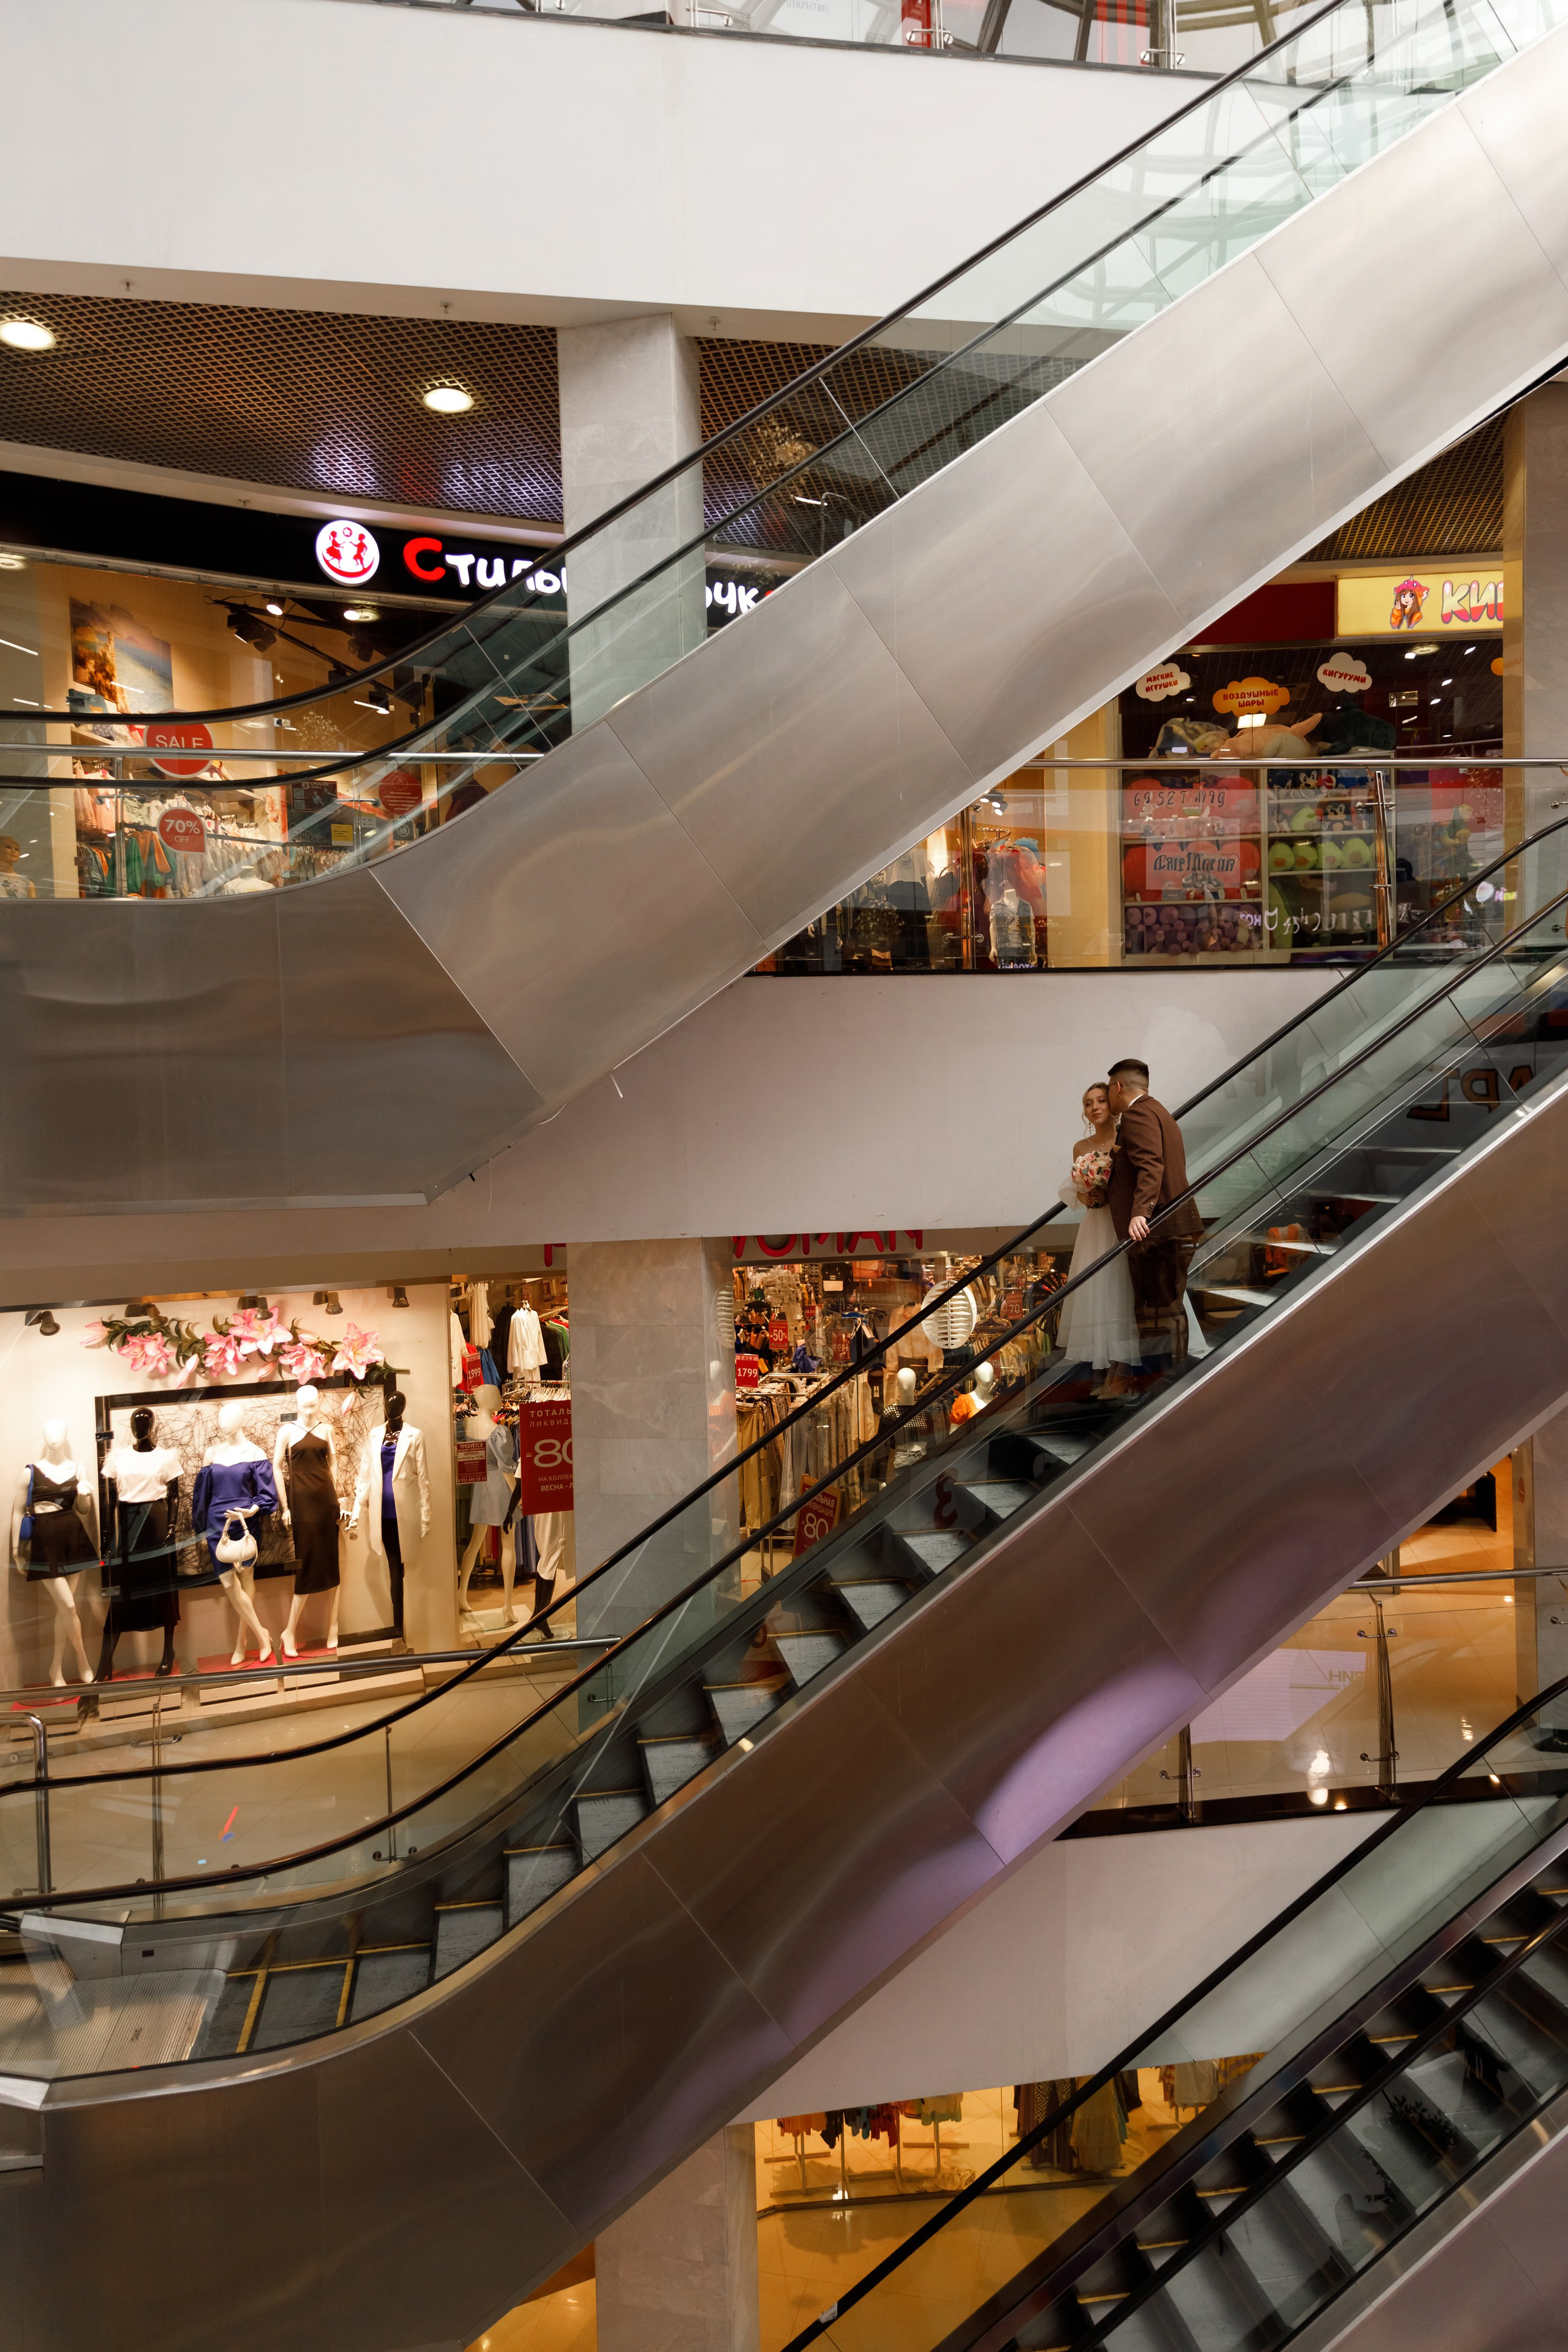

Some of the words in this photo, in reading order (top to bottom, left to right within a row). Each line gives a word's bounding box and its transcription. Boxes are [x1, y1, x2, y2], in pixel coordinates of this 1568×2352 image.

[1146, 671, 1174, 683] МЯГКИЕ
[1322, 668, 1366, 684] КИГУРУМИ
[1145, 679, 1178, 693] ИГРУШКИ
[1223, 688, 1279, 700] ВОЗДУШНЫЕ
[1238, 699, 1264, 708] ШАРЫ
[165, 819, 200, 834] 70%
[1009, 1304, 1020, 1314] 70
[468, 1368, 481, 1379] 1999
[737, 1368, 758, 1378] 1799
[529, 1419, 572, 1428] ЛИКВИД
[807, 1501, 834, 1518] ИКВИДАЦИЯ
[804, 1512, 829, 1541] 80
